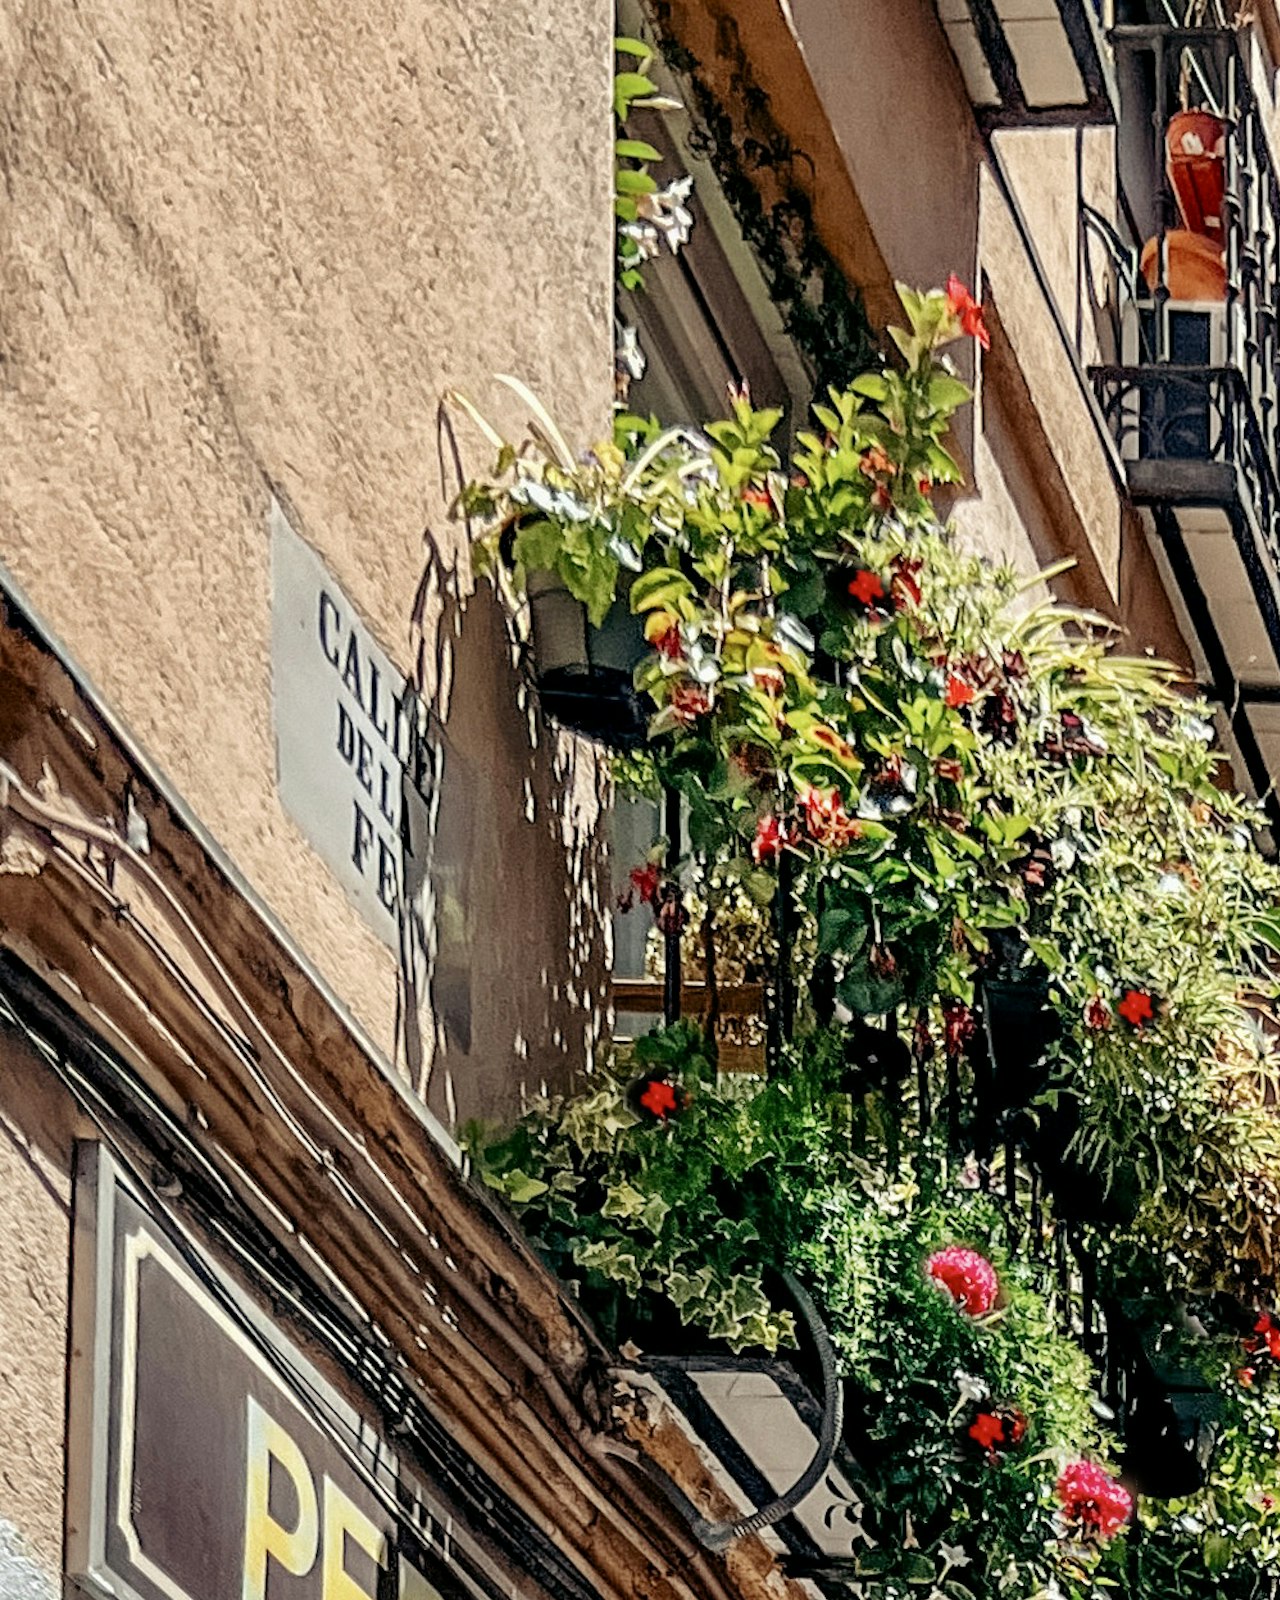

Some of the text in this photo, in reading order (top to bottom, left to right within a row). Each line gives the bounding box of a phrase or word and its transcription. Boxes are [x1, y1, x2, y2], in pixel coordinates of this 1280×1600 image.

[317, 589, 435, 804] CALLE
[336, 697, 414, 858] DE LA
[351, 800, 400, 919] FE
